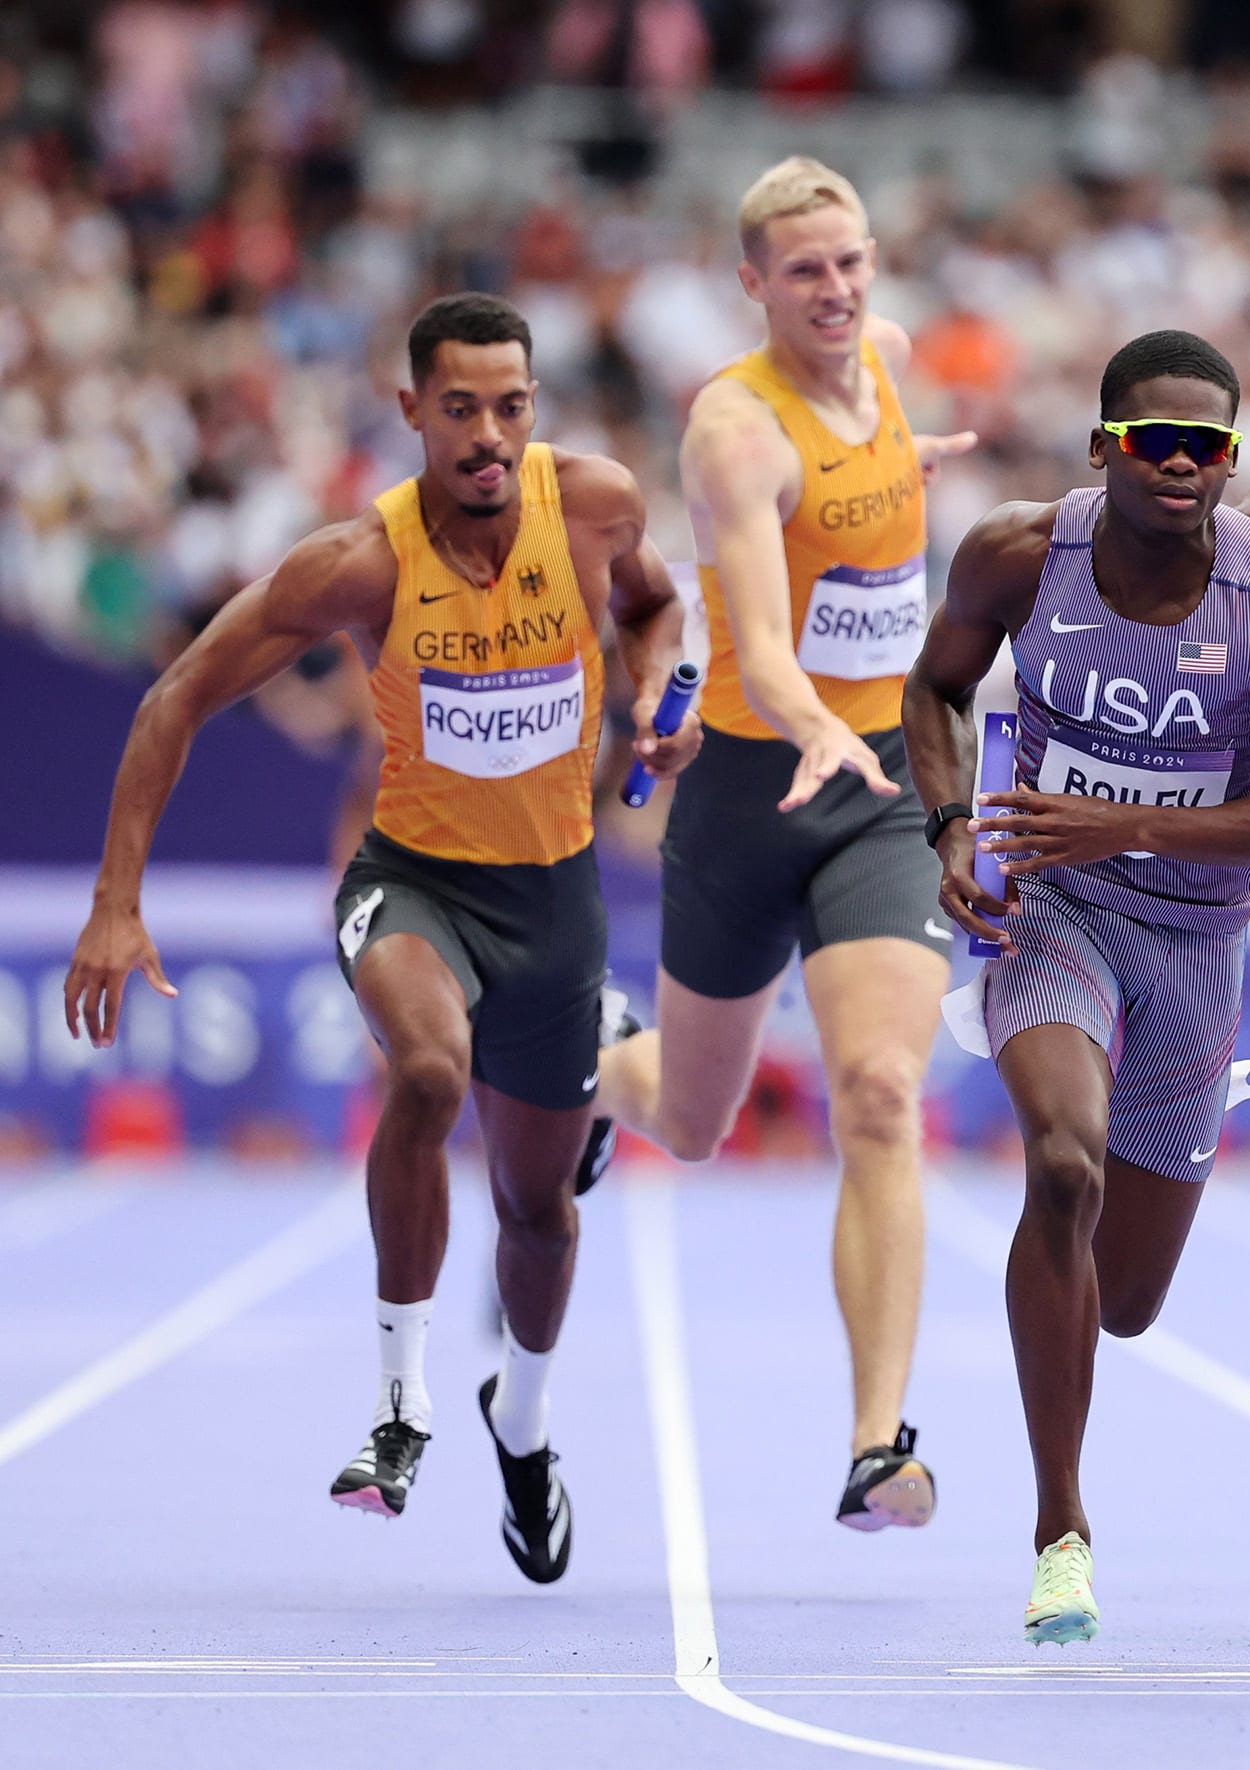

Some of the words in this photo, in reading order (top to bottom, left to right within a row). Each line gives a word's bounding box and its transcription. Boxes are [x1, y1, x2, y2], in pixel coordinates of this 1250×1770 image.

[414, 609, 566, 661] GERMANY
[462, 674, 507, 689] PARIS
[510, 671, 550, 686] 2024
[1042, 659, 1210, 737] USA
[425, 691, 580, 743] AGYEKUM
[1091, 742, 1136, 761] PARIS
[1142, 754, 1185, 767] 2024
